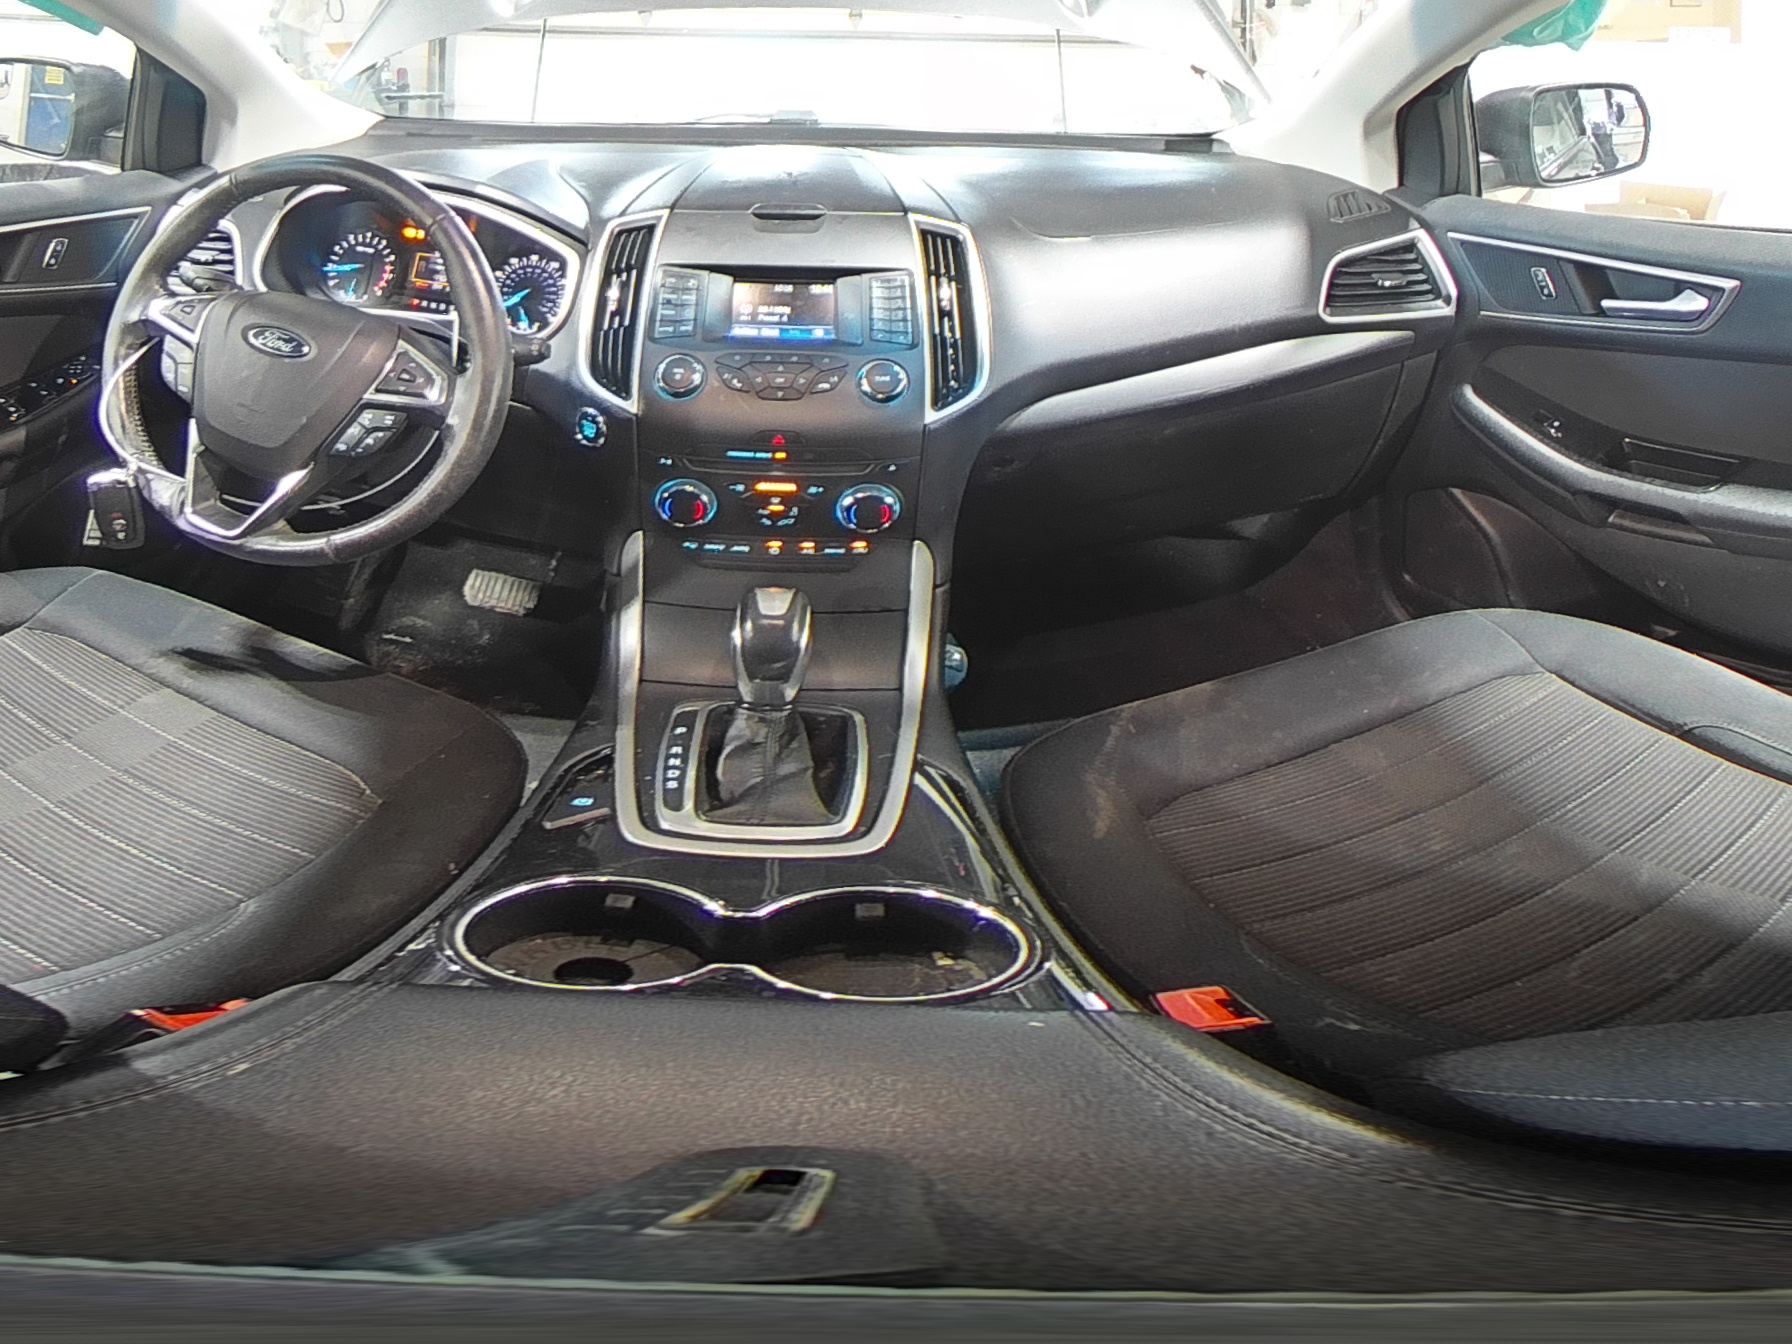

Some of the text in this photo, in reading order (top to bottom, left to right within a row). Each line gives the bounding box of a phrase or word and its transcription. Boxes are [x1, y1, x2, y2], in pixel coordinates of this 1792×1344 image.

[258, 330, 297, 352] Ford
[673, 726, 688, 736] P
[665, 769, 682, 778] D
